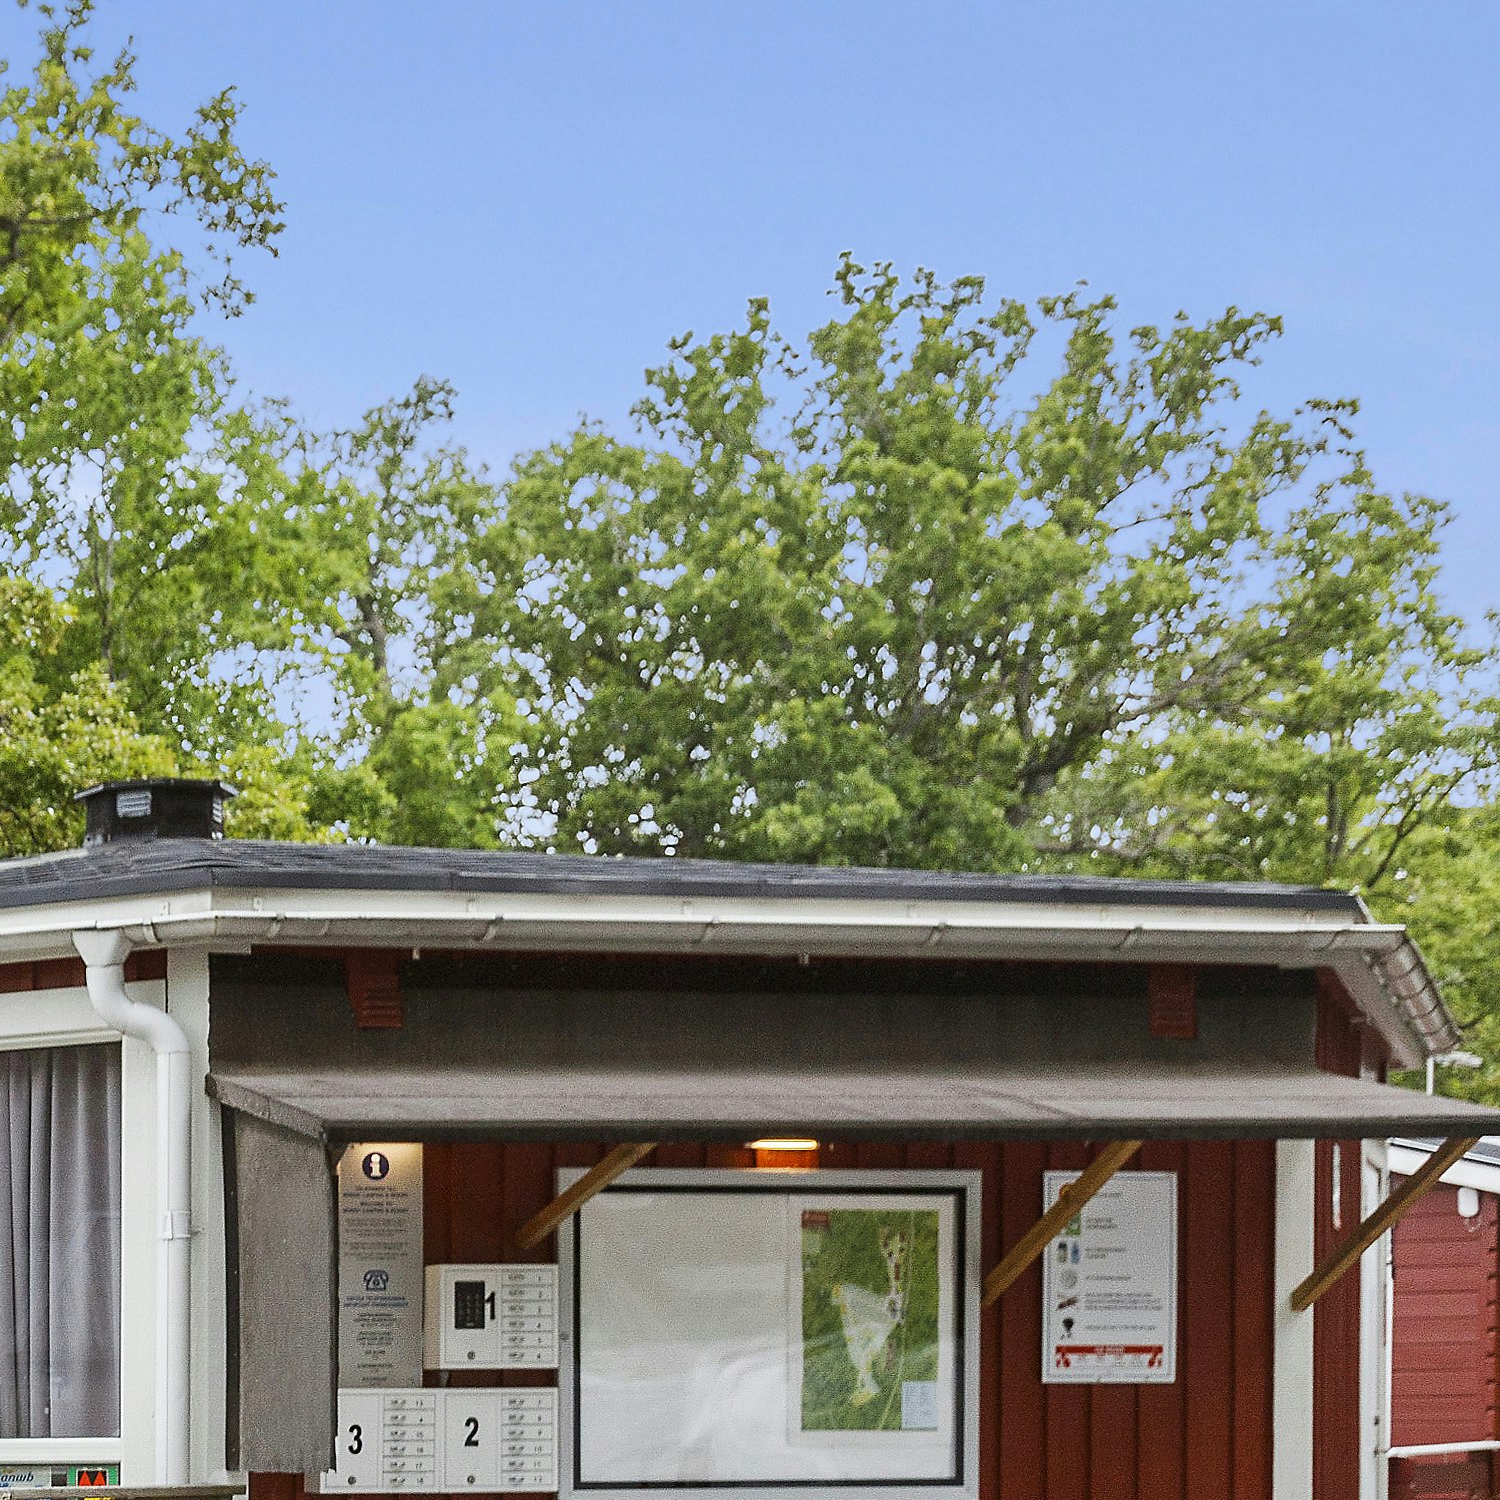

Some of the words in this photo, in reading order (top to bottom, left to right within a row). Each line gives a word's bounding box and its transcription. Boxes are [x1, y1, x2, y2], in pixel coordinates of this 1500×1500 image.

[485, 1291, 496, 1320] 1
[348, 1424, 363, 1454] 3
[464, 1416, 480, 1447] 2
[0, 1472, 35, 1483] anwb
